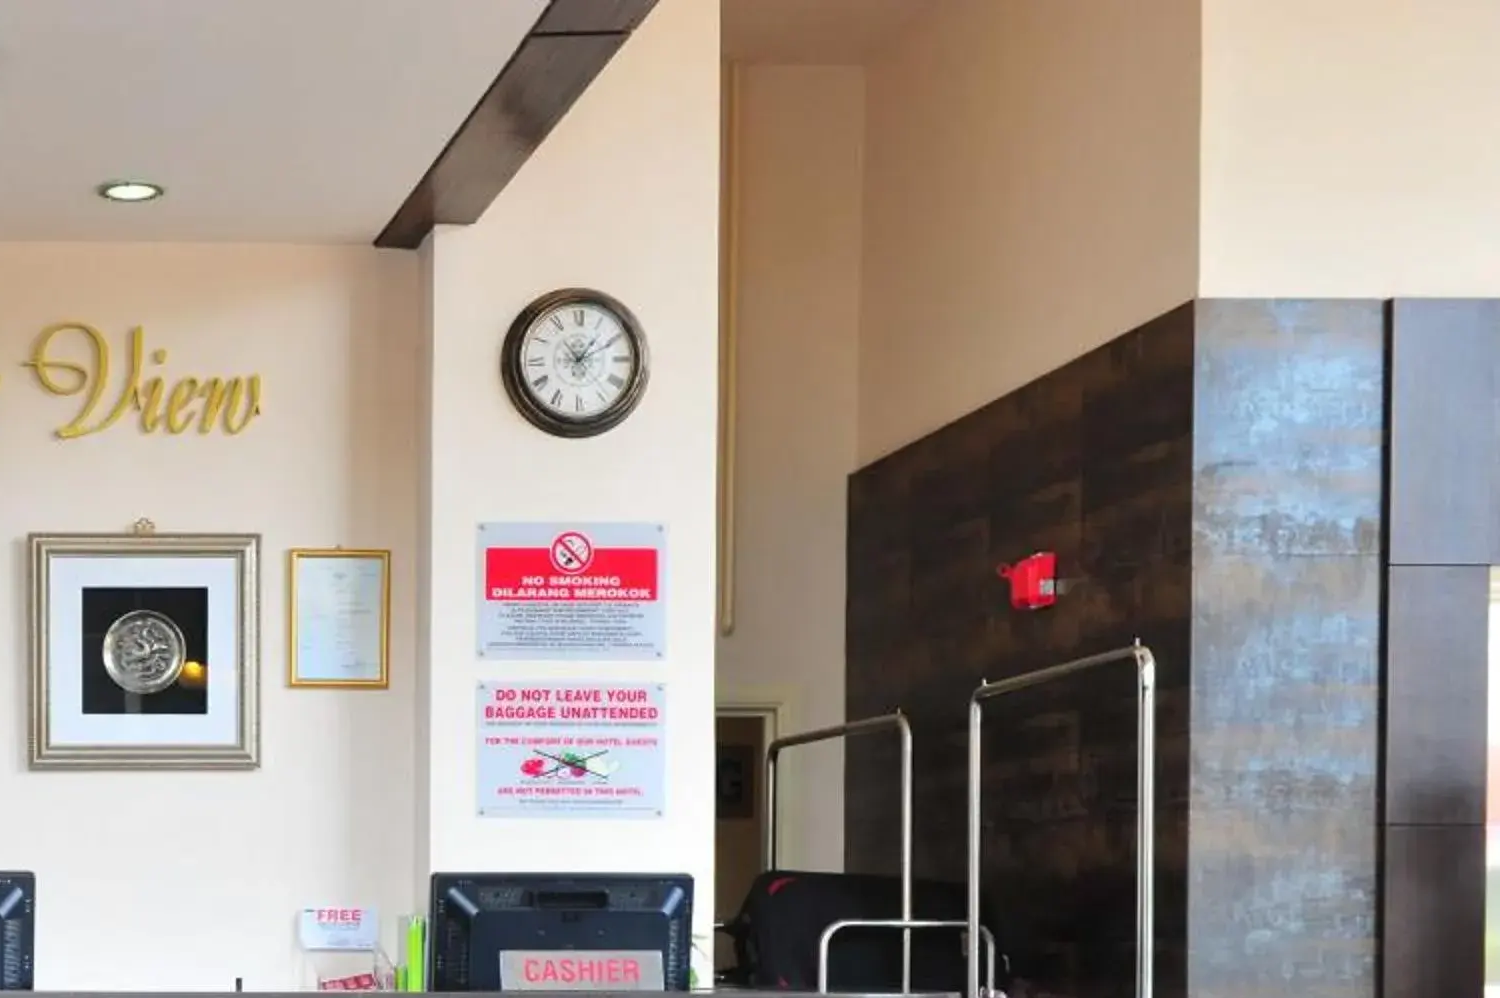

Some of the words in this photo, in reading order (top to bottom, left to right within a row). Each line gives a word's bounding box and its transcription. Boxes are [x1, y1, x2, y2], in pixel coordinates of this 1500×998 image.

[19, 322, 262, 440] View
[521, 575, 544, 586] NO
[549, 575, 621, 587] SMOKING
[492, 587, 570, 598] DILARANG
[574, 588, 651, 599] MEROKOK
[496, 689, 516, 702] DO
[522, 689, 551, 702] NOT
[556, 689, 601, 702] LEAVE
[607, 690, 648, 703] YOUR
[485, 706, 557, 719] BAGGAGE
[561, 707, 658, 720] UNATTENDED
[318, 908, 362, 921] FREE
[524, 959, 641, 983] CASHIER
